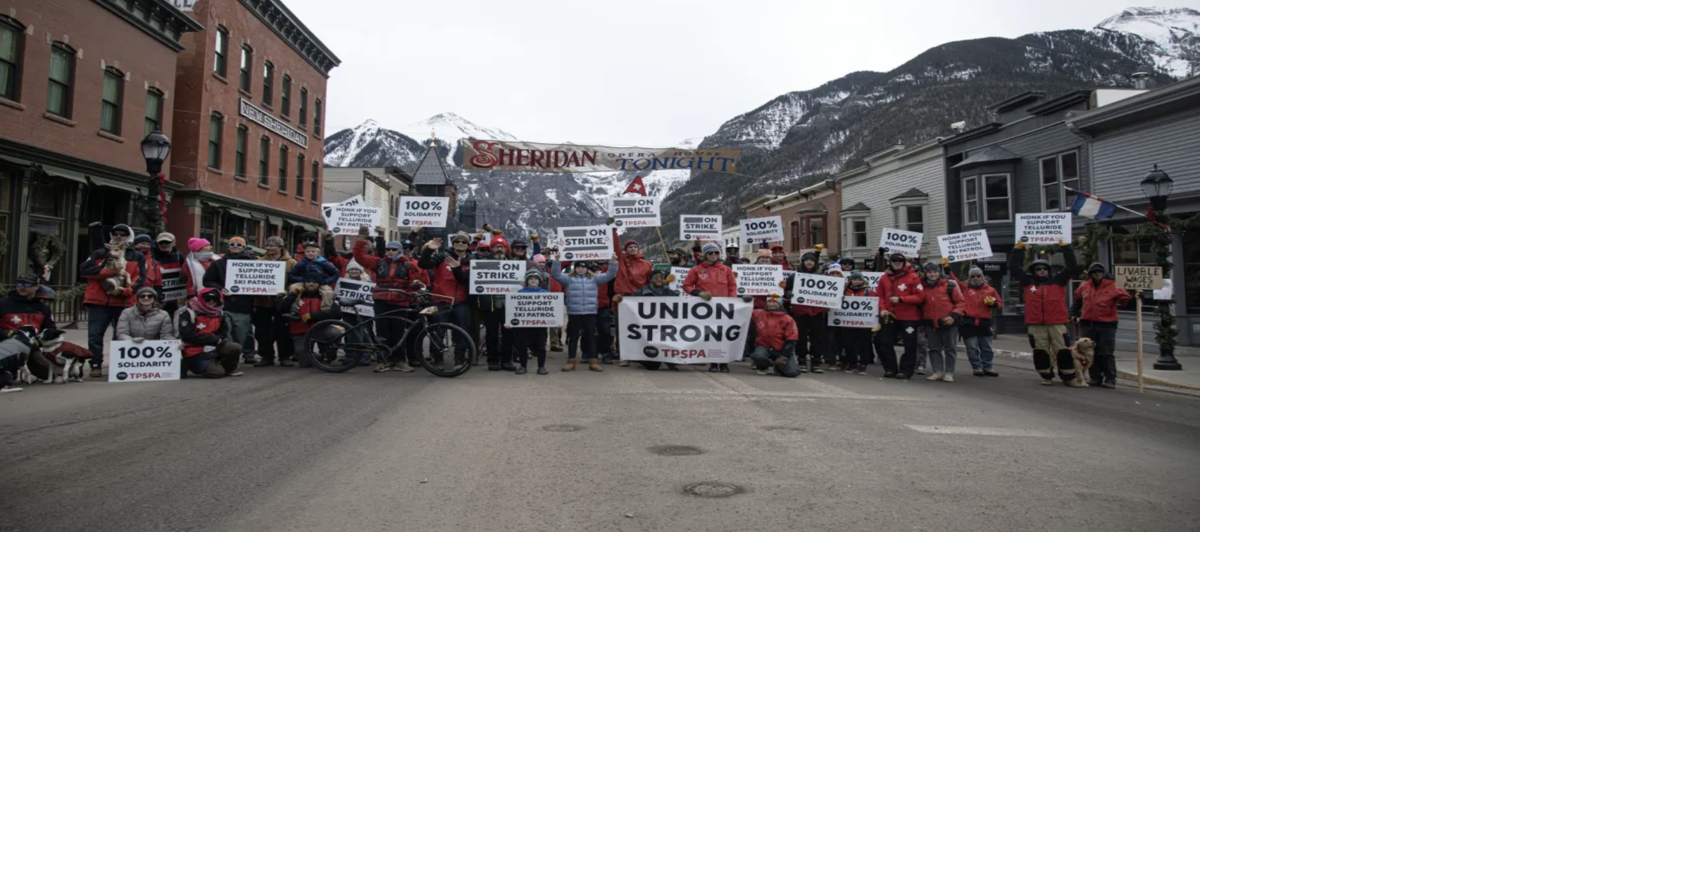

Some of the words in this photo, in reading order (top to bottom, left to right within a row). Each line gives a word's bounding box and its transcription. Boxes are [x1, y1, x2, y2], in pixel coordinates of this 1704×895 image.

[242, 102, 262, 122] NEW
[264, 115, 306, 147] SHERIDAN
[469, 140, 598, 170] SHERIDAN
[616, 156, 734, 171] TONIGHT
[406, 200, 442, 210] 100%
[745, 220, 777, 230] 100%
[887, 232, 917, 244] 100%
[885, 241, 916, 250] SOLIDARITY
[948, 242, 981, 250] TELLURIDE
[477, 272, 518, 280] STRIKE,
[1118, 267, 1159, 276] LIVABLE
[800, 278, 838, 291] 100%
[798, 289, 838, 298] SOLIDARITY
[638, 302, 734, 320] UNION
[841, 300, 873, 311] 00%
[627, 324, 741, 342] STRONG
[118, 346, 172, 359] 100%
[661, 349, 706, 358] TPSPA
